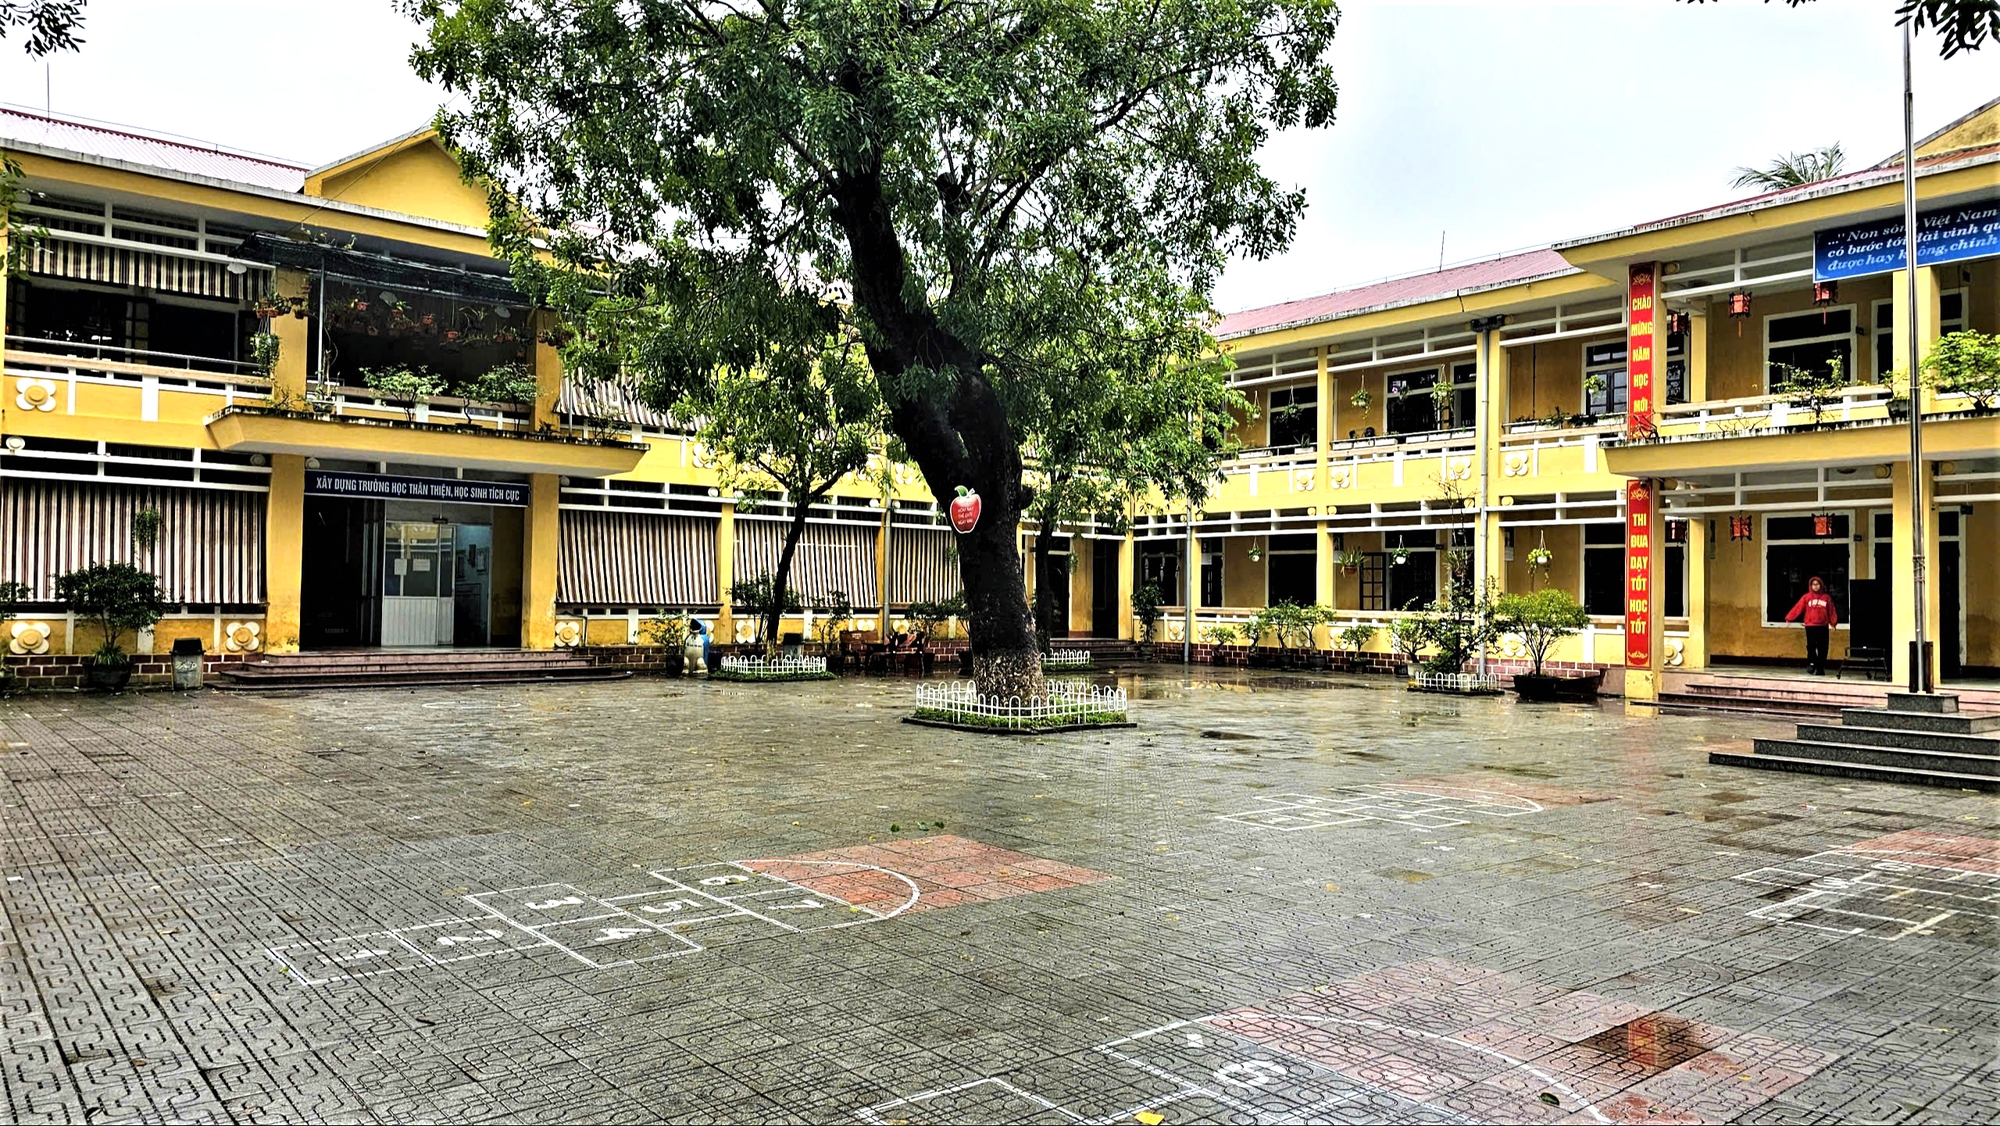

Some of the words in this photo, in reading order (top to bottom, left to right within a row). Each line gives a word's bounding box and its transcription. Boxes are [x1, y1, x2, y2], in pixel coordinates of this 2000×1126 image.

[1924, 214, 1951, 228] Việt
[1956, 209, 1998, 223] Nam
[1827, 245, 1845, 258] có
[1847, 241, 1884, 255] bước
[1943, 227, 1979, 239] vinh
[1827, 259, 1864, 271] được
[1865, 254, 1895, 269] hay
[1898, 245, 1949, 260] kông,
[1949, 234, 1999, 251] chính
[1632, 294, 1652, 311] CHÀO
[1630, 320, 1653, 337] MỪNG
[1632, 346, 1651, 362] NĂM
[1633, 373, 1649, 389] HỌC
[1633, 396, 1649, 413] MỚI
[316, 475, 333, 490] XÂY
[334, 478, 357, 492] DỰNG
[358, 478, 390, 493] TRƯỜNG
[391, 482, 407, 496] HỌC
[408, 481, 429, 496] THÂN
[454, 485, 469, 500] HỌC
[470, 486, 488, 499] SINH
[488, 486, 504, 500] TÍCH
[505, 489, 520, 502] CỰC
[1633, 512, 1647, 527] THI
[1630, 534, 1648, 549] ĐUA
[1630, 556, 1648, 572] DẠY
[1630, 573, 1647, 591] TỐT
[1629, 598, 1648, 615] HỌC
[1630, 616, 1647, 634] TỐT
